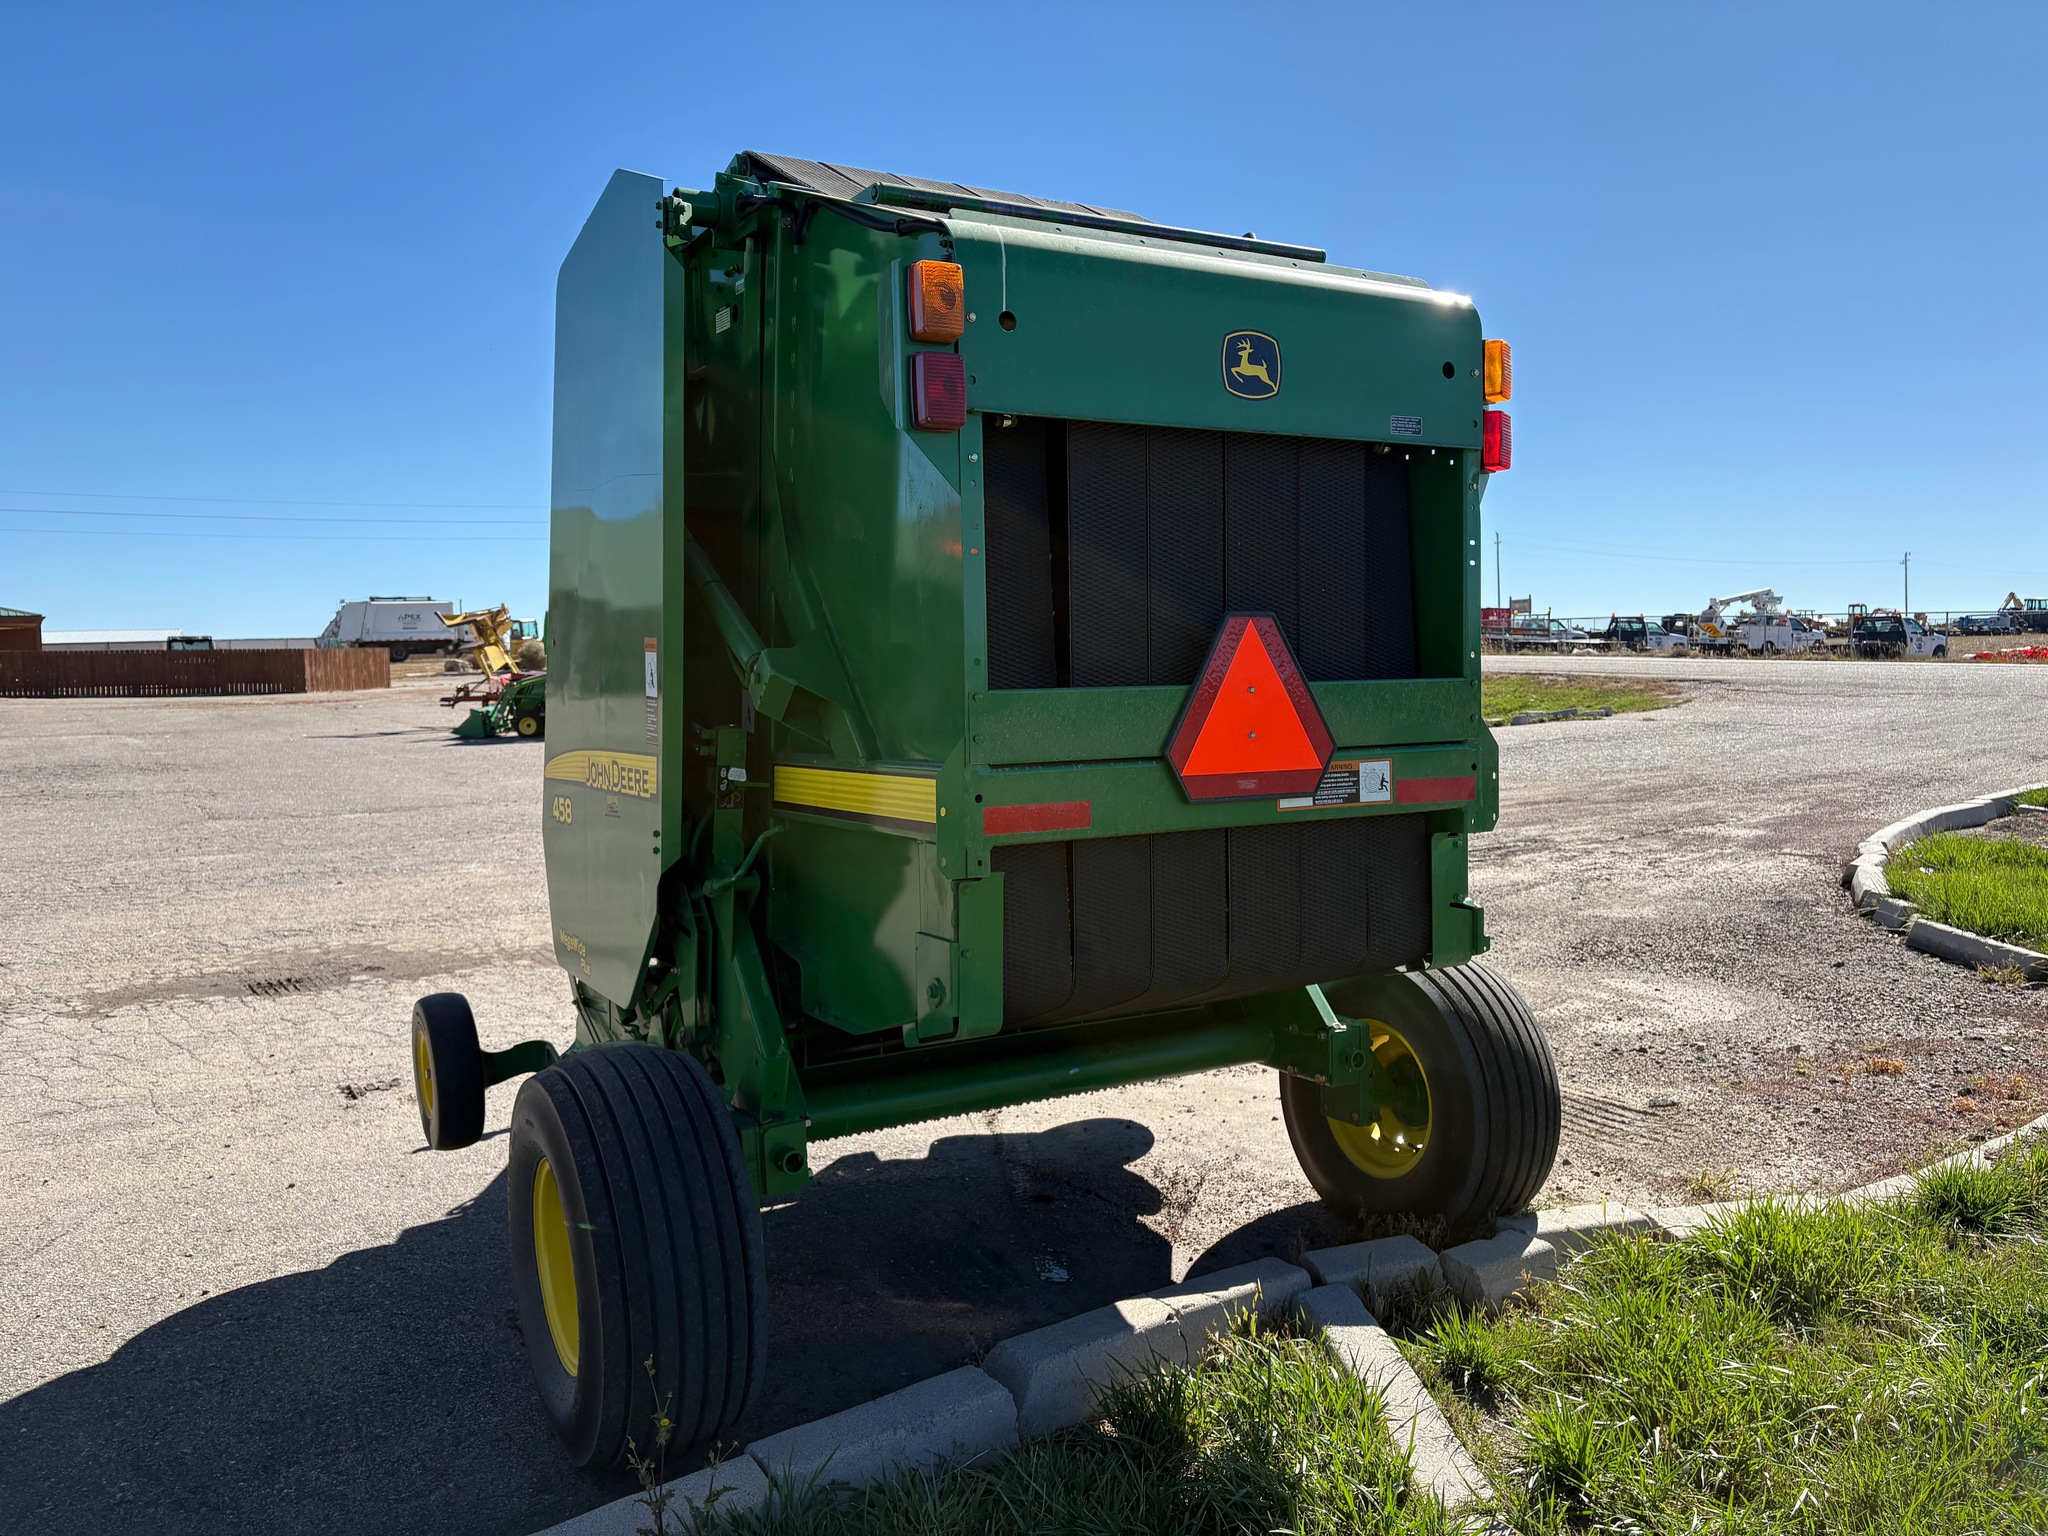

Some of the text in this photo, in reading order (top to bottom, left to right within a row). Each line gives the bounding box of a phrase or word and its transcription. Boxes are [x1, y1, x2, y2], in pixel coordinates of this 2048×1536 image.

[398, 613, 421, 622] APEX
[1329, 763, 1353, 771] ARNING
[553, 795, 573, 824] 458
[560, 928, 587, 958] MegaWide
